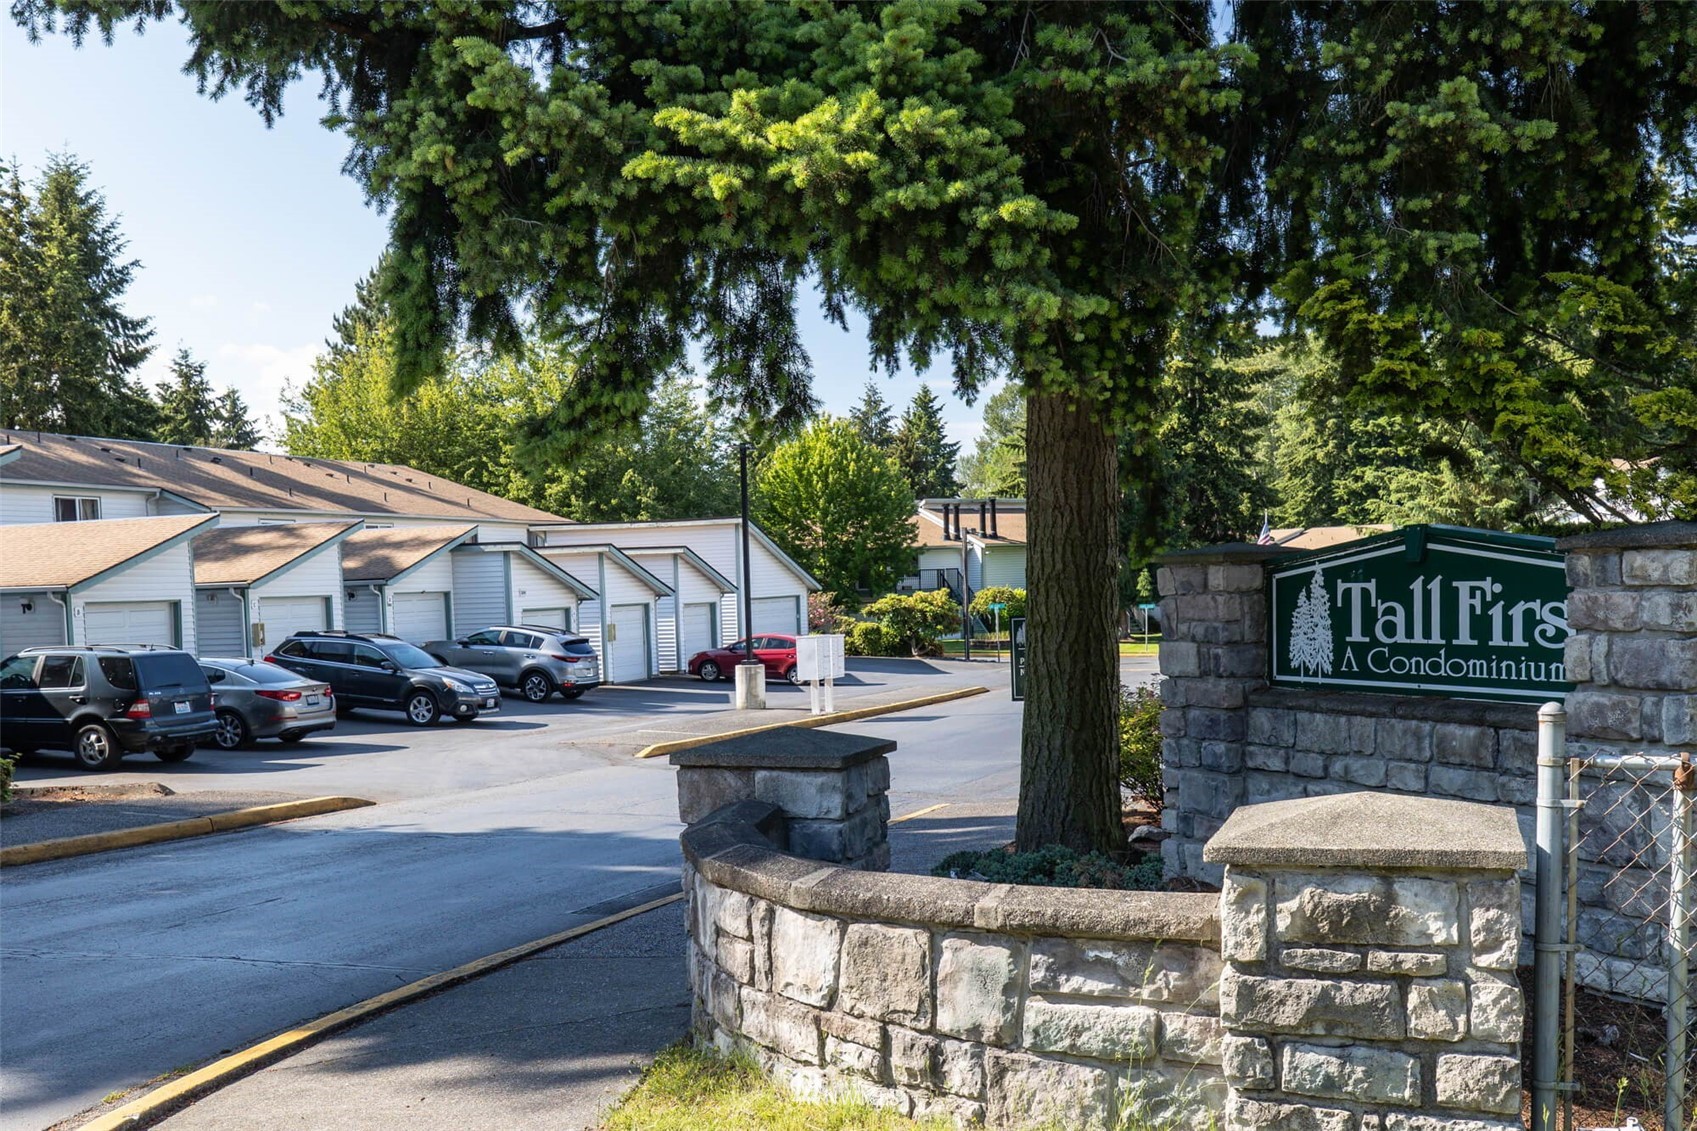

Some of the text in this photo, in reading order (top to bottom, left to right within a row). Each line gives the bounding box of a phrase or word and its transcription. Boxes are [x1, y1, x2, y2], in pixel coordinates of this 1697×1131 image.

[1337, 575, 1576, 649] Tall Firs
[1340, 646, 1359, 672] A
